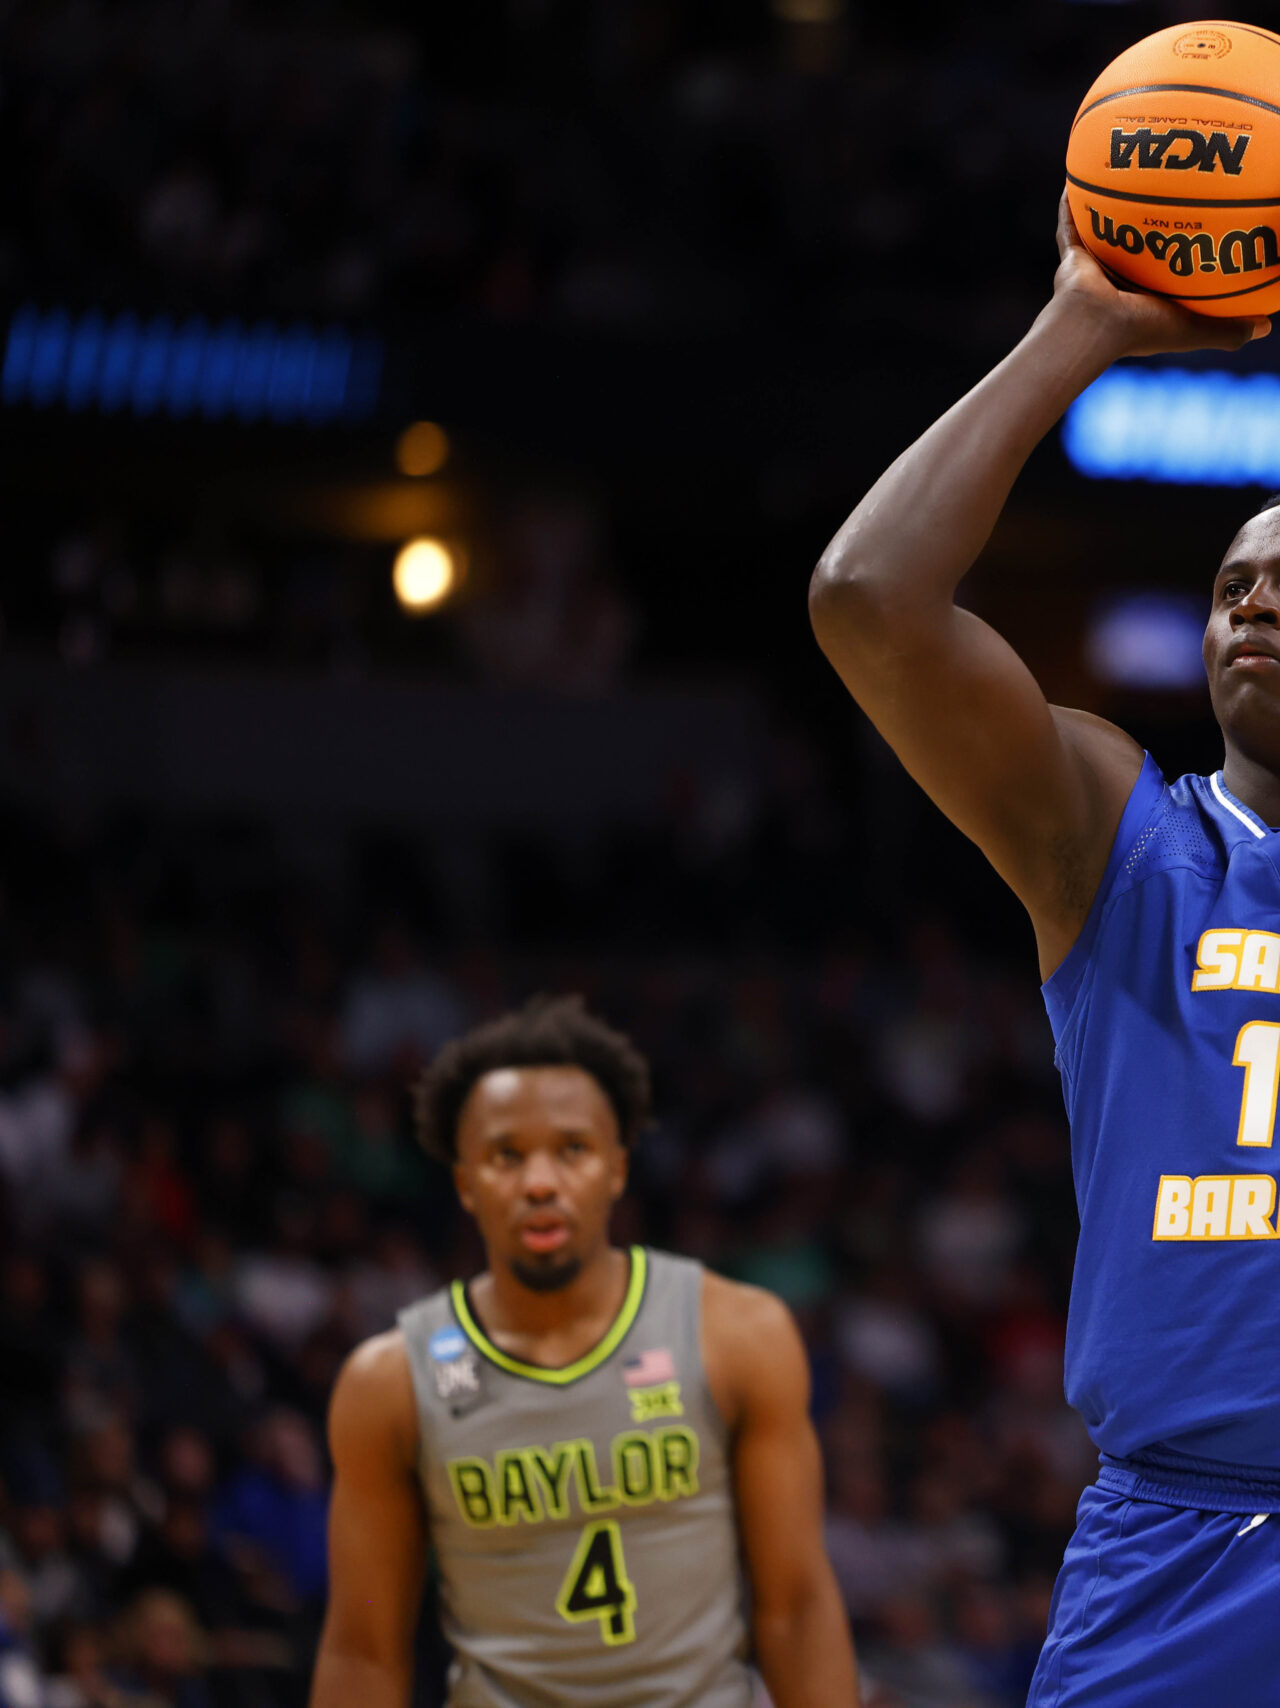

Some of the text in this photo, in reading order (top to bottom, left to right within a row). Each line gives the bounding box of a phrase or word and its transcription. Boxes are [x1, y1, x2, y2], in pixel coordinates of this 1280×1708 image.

[1114, 115, 1253, 131] OFFICIAL GAME BALL
[1110, 127, 1251, 176] NCAA
[1142, 217, 1203, 230] EVO NXT
[447, 1425, 700, 1530] BAYLOR
[556, 1519, 637, 1646] 4
